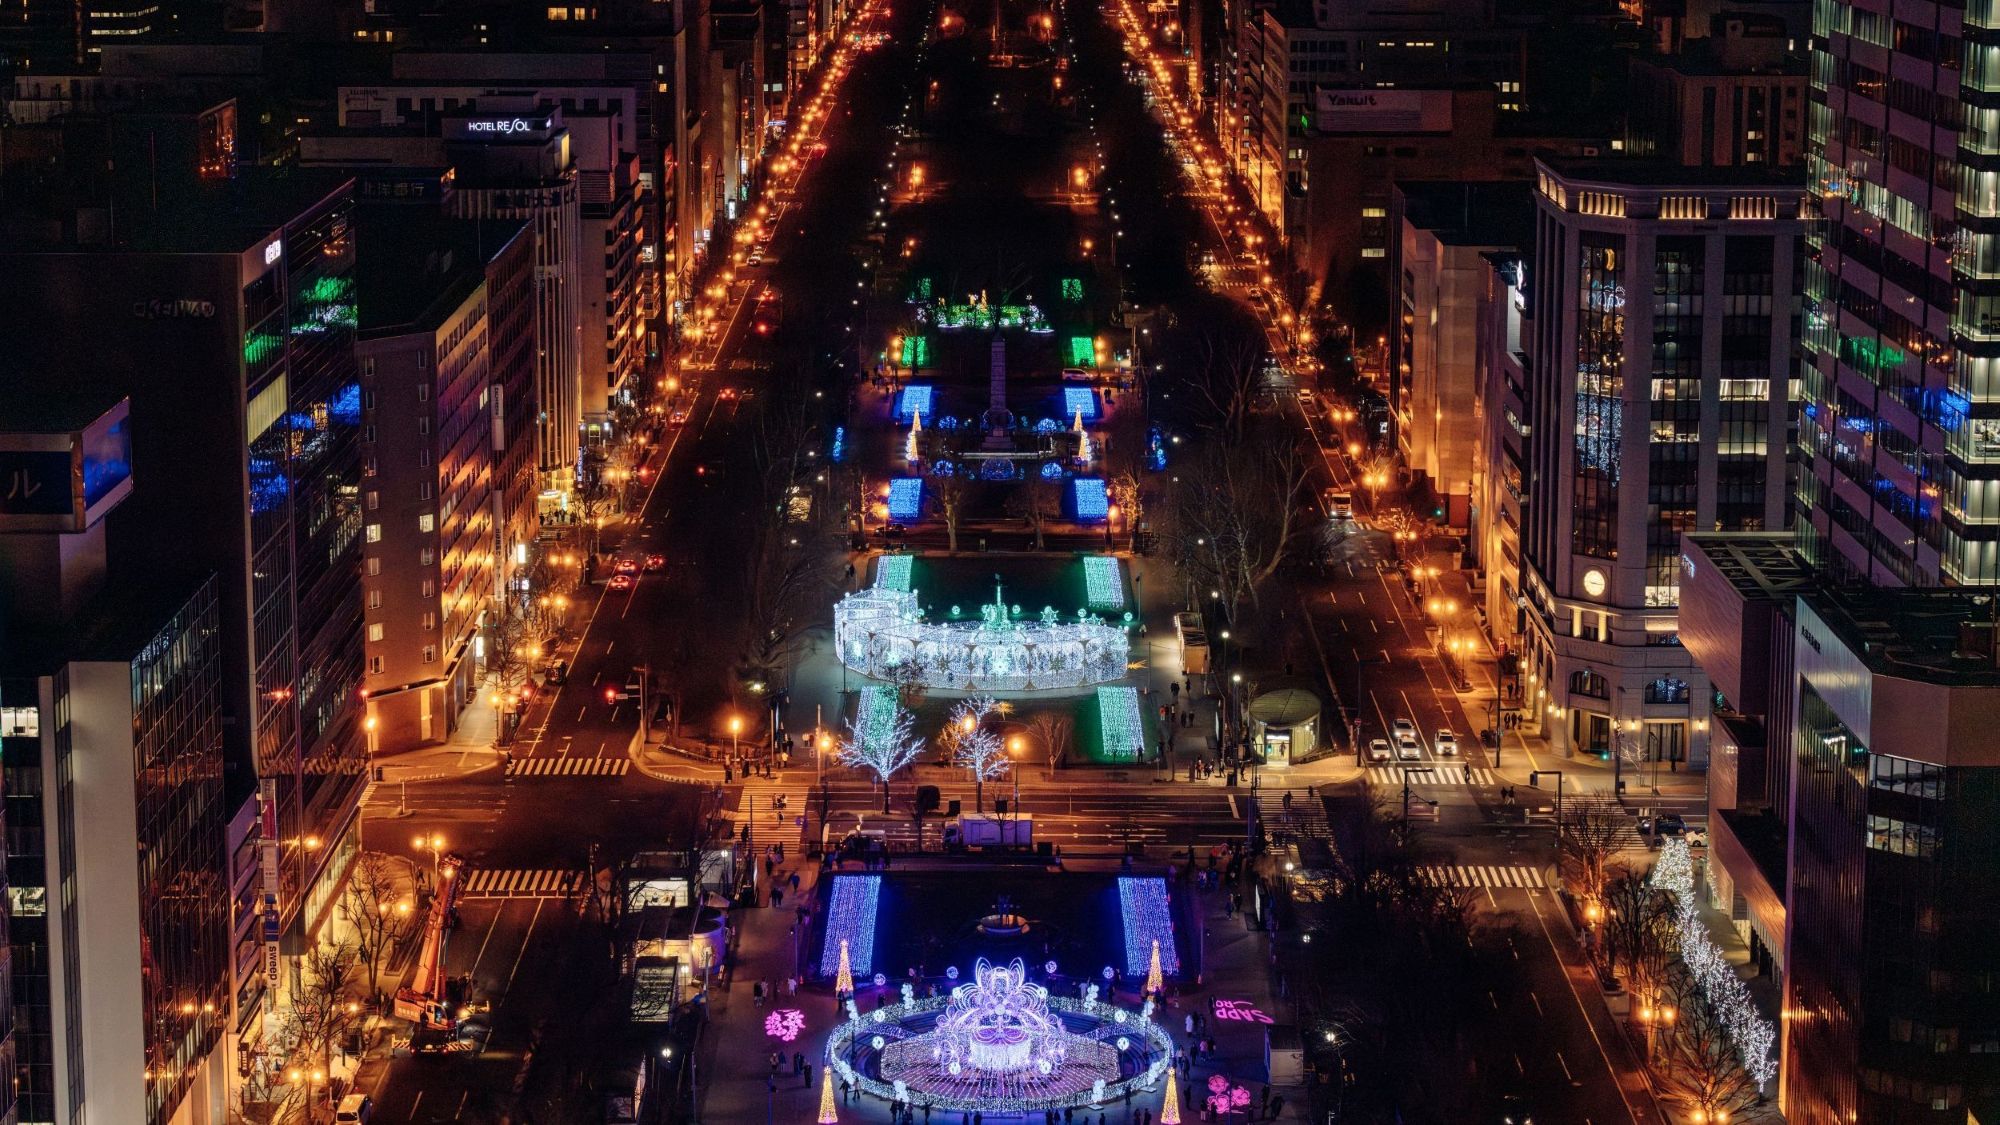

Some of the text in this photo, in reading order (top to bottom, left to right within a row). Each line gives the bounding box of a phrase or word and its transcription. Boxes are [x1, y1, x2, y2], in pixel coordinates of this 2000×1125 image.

[1328, 94, 1377, 106] Yakult
[468, 122, 496, 131] HOTEL
[7, 468, 42, 500] ル
[268, 946, 278, 981] sweep
[1215, 1008, 1275, 1024] SAPP
